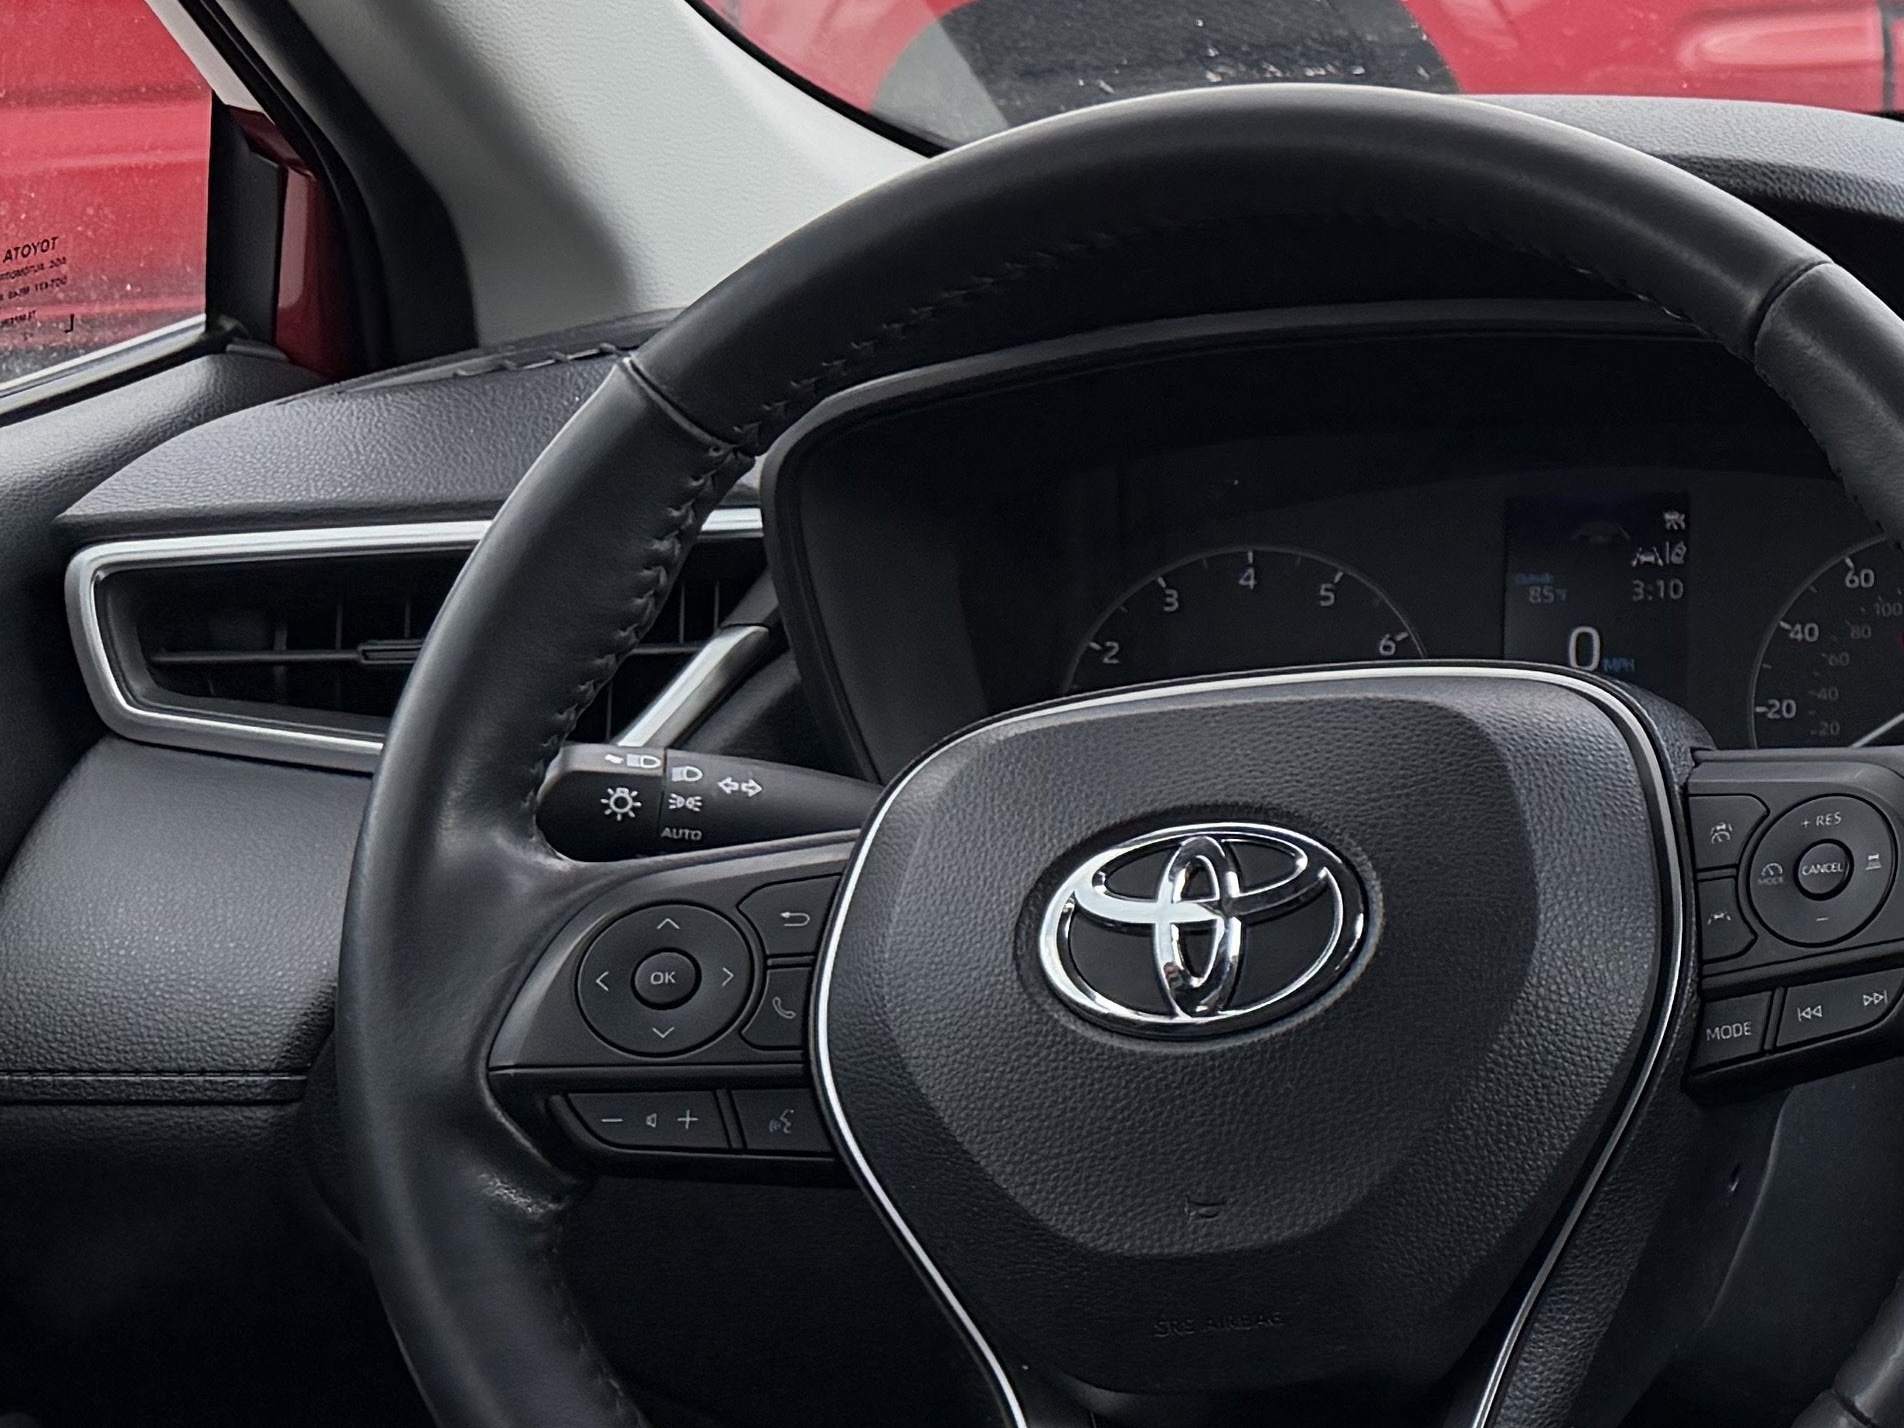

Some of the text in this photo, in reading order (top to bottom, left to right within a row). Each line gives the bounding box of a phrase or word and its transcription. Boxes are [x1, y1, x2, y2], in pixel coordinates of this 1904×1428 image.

[1239, 568, 1257, 590] 4
[1845, 568, 1876, 589] 60
[1163, 589, 1180, 612] 3
[1319, 583, 1335, 606] 5
[1632, 578, 1684, 602] 3:10
[1875, 602, 1904, 618] 100
[1789, 622, 1820, 643] 40
[1850, 624, 1873, 641] 80
[1102, 641, 1120, 664] 2
[1379, 634, 1396, 656] 6
[1568, 624, 1601, 672] 0
[1765, 698, 1798, 720] 20
[1816, 812, 1842, 827] RES
[661, 827, 702, 840] AUTO
[1801, 862, 1844, 877] CANCEL
[650, 971, 676, 985] OK
[1706, 1021, 1752, 1042] MODE
